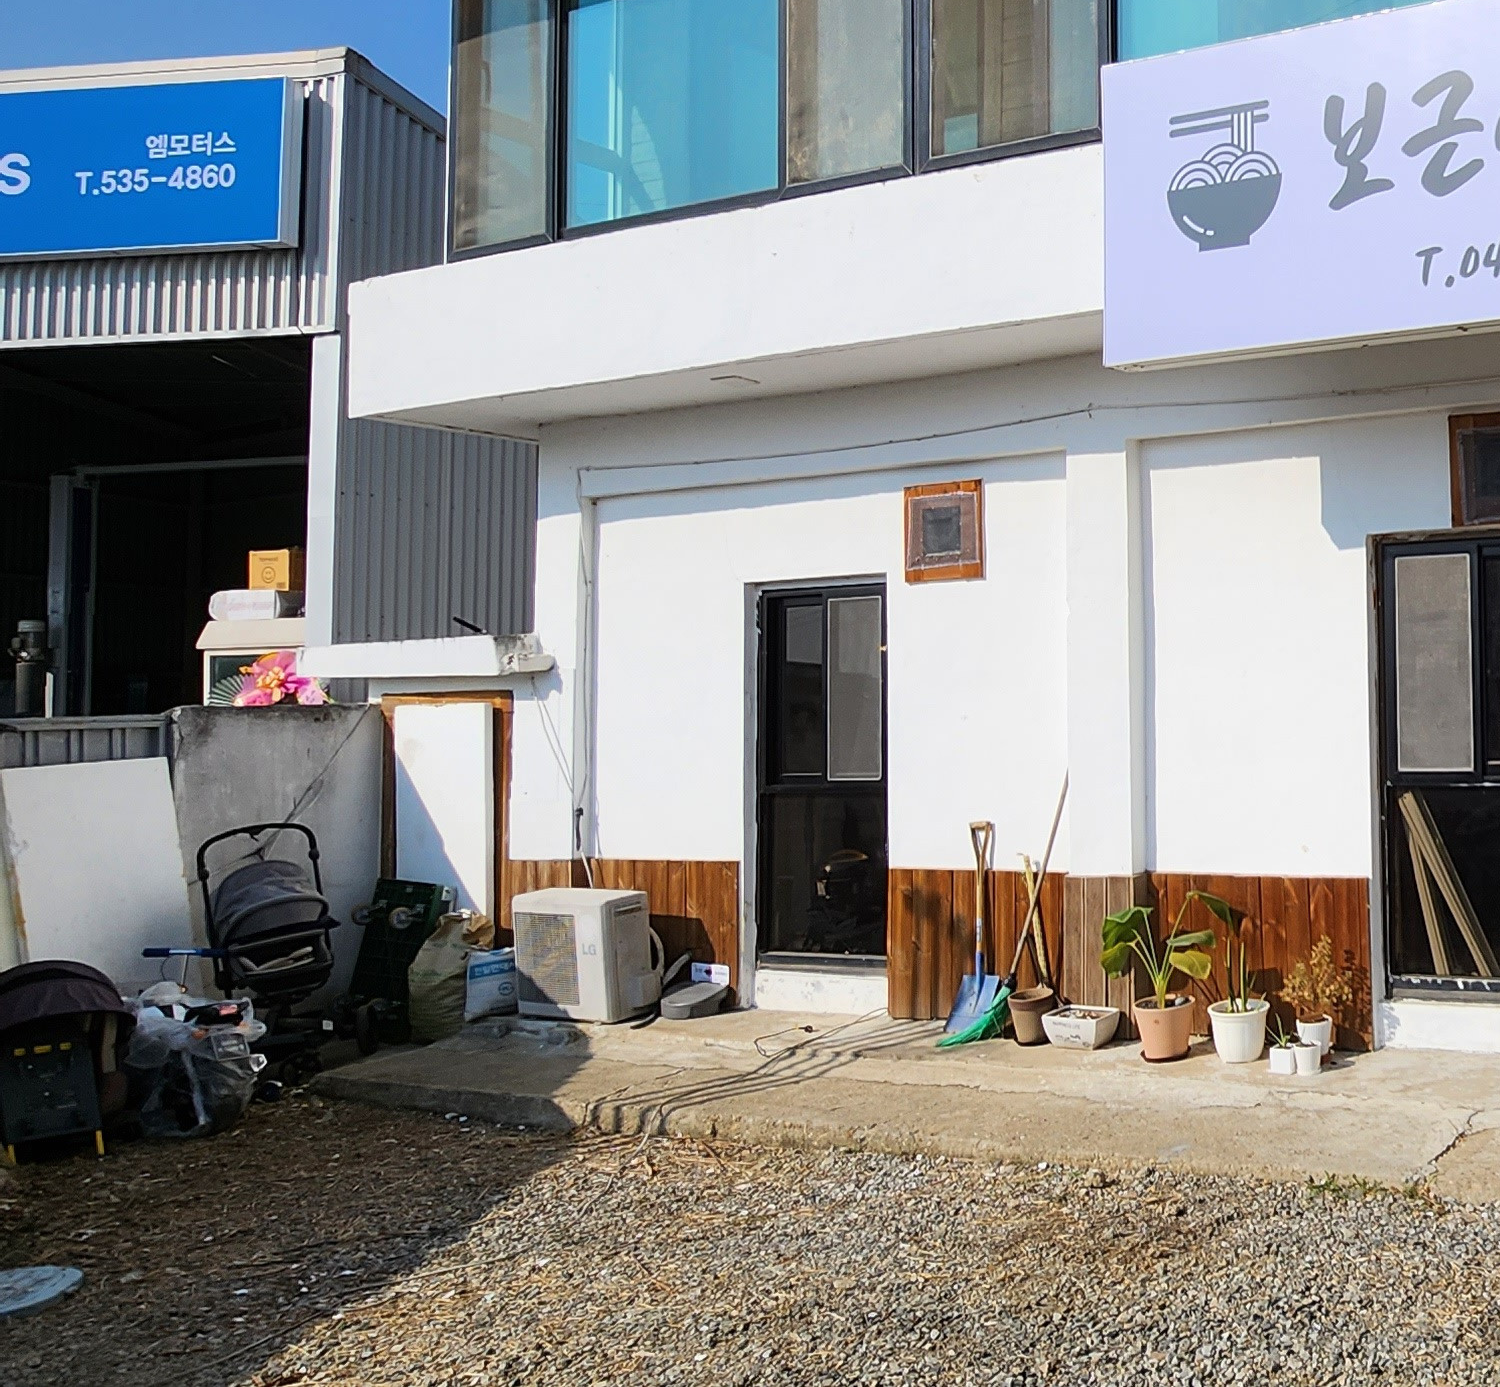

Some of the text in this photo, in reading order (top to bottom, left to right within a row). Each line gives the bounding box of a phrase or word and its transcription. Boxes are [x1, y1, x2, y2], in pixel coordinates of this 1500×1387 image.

[145, 131, 237, 159] 엠모터스
[74, 163, 237, 196] T.535-4860
[582, 943, 597, 956] LG
